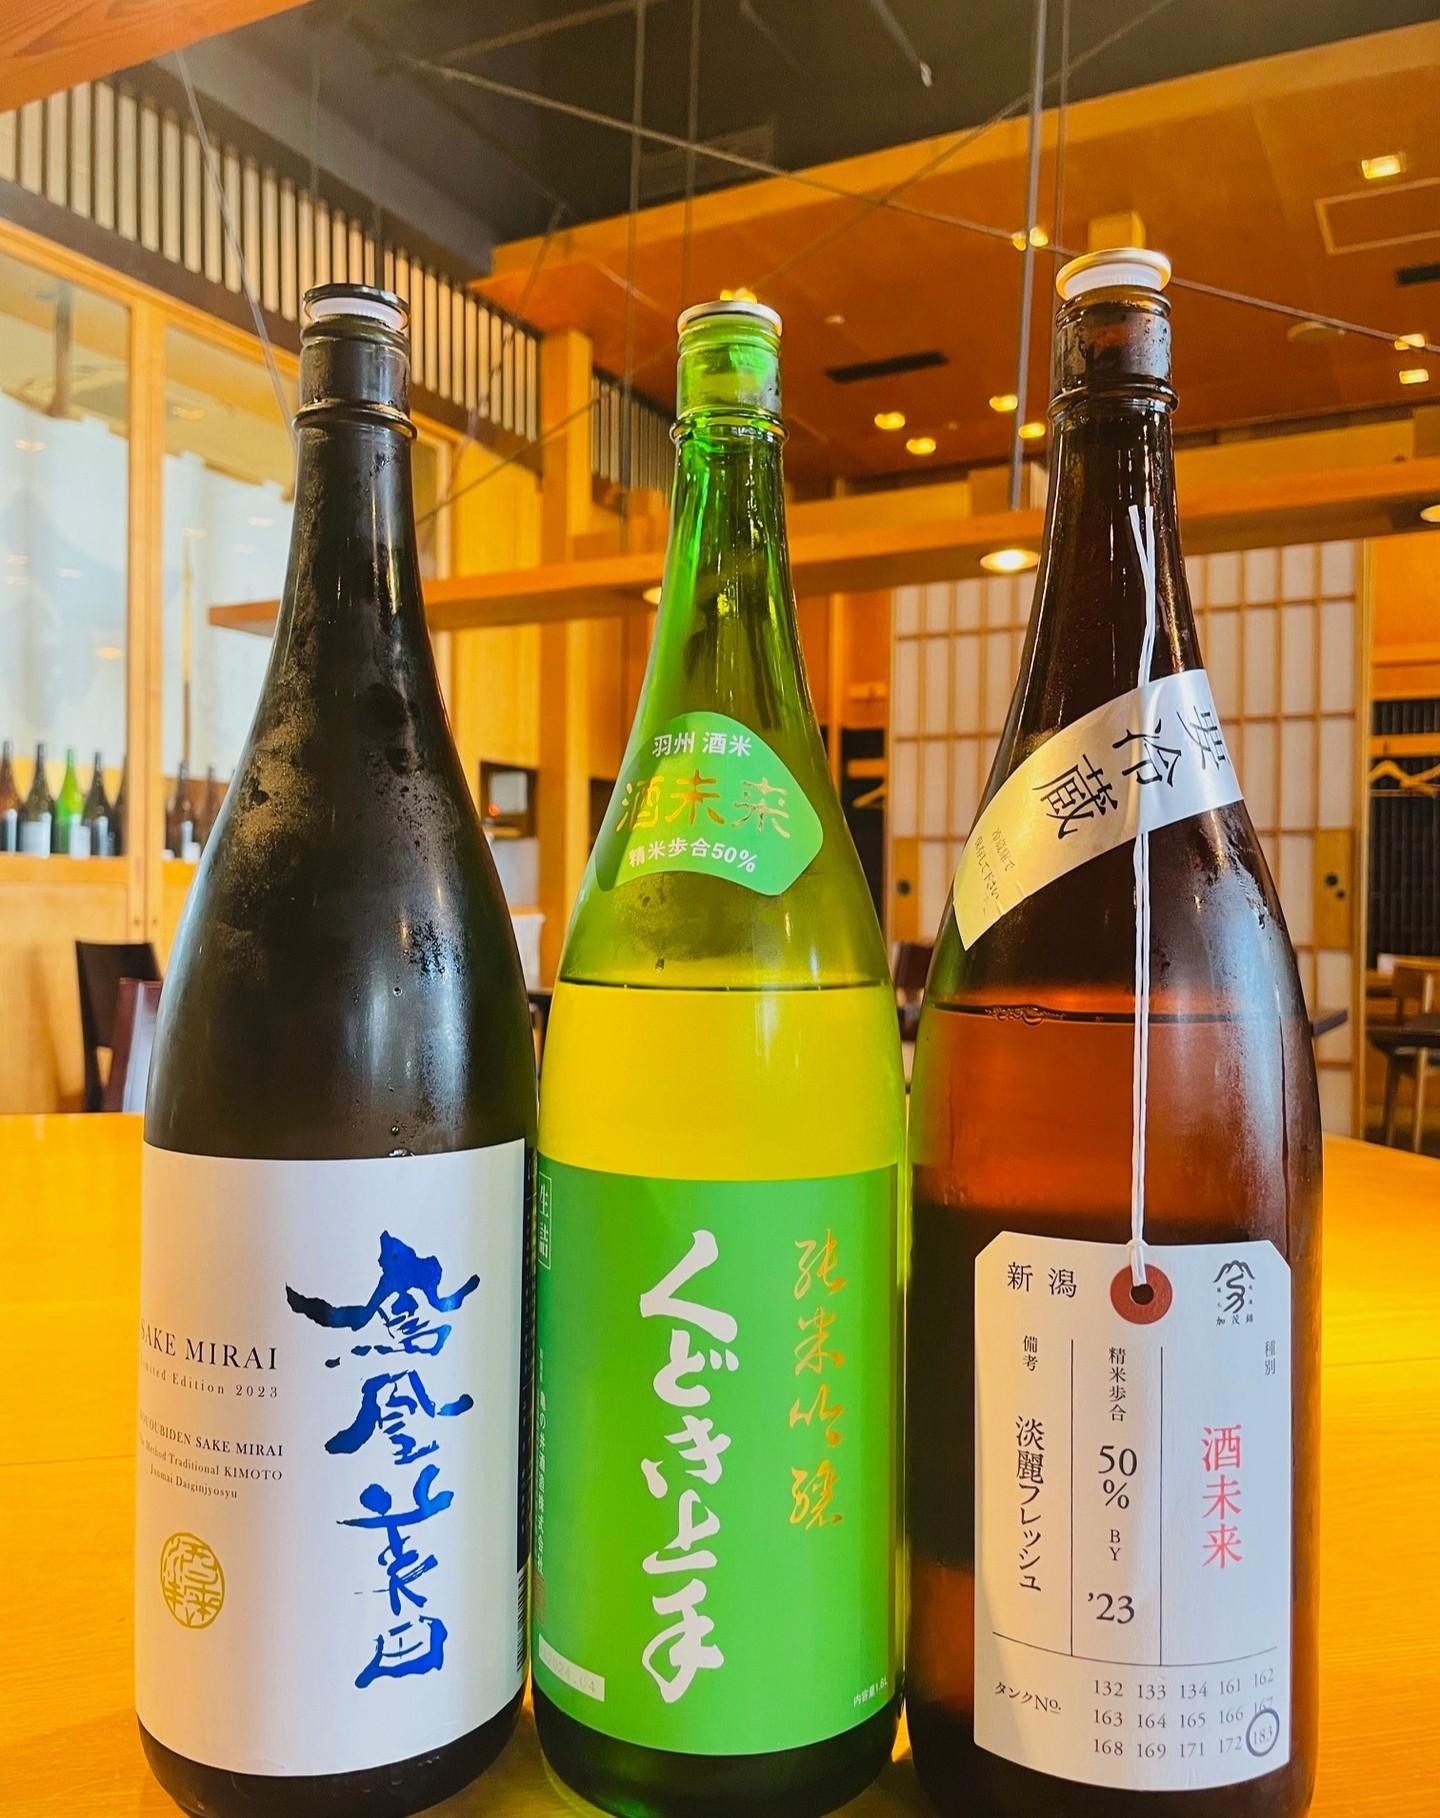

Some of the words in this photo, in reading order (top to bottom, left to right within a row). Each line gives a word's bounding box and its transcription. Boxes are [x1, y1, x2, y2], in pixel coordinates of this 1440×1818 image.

[652, 731, 696, 757] 羽州
[702, 730, 753, 757] 酒米
[1031, 704, 1228, 840] 要冷蔵
[615, 768, 791, 839] 酒未来
[628, 838, 759, 874] 精米歩合50%
[1007, 1261, 1077, 1298] 新潟
[140, 1318, 176, 1357] SAKE
[185, 1337, 278, 1370] MIRAI
[1022, 1334, 1039, 1372] 備考
[1264, 1339, 1276, 1376] 種別
[172, 1372, 225, 1395] Edition
[235, 1384, 278, 1399] 2023
[788, 1228, 847, 1531] 純米吟醸
[1108, 1346, 1127, 1422] 精米歩合
[195, 1435, 231, 1454] SAKE
[236, 1441, 284, 1458] MIRAI
[285, 1229, 481, 1690] 鳳凰美田
[150, 1463, 173, 1485] Junmai
[175, 1475, 238, 1500] Daiginjyosyu
[168, 1451, 220, 1477] Traditional
[223, 1465, 283, 1481] KIMOTO
[639, 1229, 740, 1704] くどき上手
[1014, 1415, 1046, 1592] 淡麗フレッシュ
[1200, 1423, 1243, 1570] 酒未来
[1093, 1679, 1124, 1698] 132
[1136, 1683, 1167, 1701] 133
[1180, 1681, 1208, 1700] 134
[1219, 1678, 1241, 1696] 161
[1253, 1667, 1275, 1688] 162
[1093, 1708, 1123, 1727] 163
[1136, 1712, 1167, 1730] 164
[1180, 1709, 1206, 1729] 165
[1219, 1705, 1244, 1724] 166
[1093, 1738, 1123, 1756] 168
[1136, 1741, 1167, 1759] 169
[1179, 1739, 1205, 1758] 171
[1218, 1735, 1242, 1754] 172
